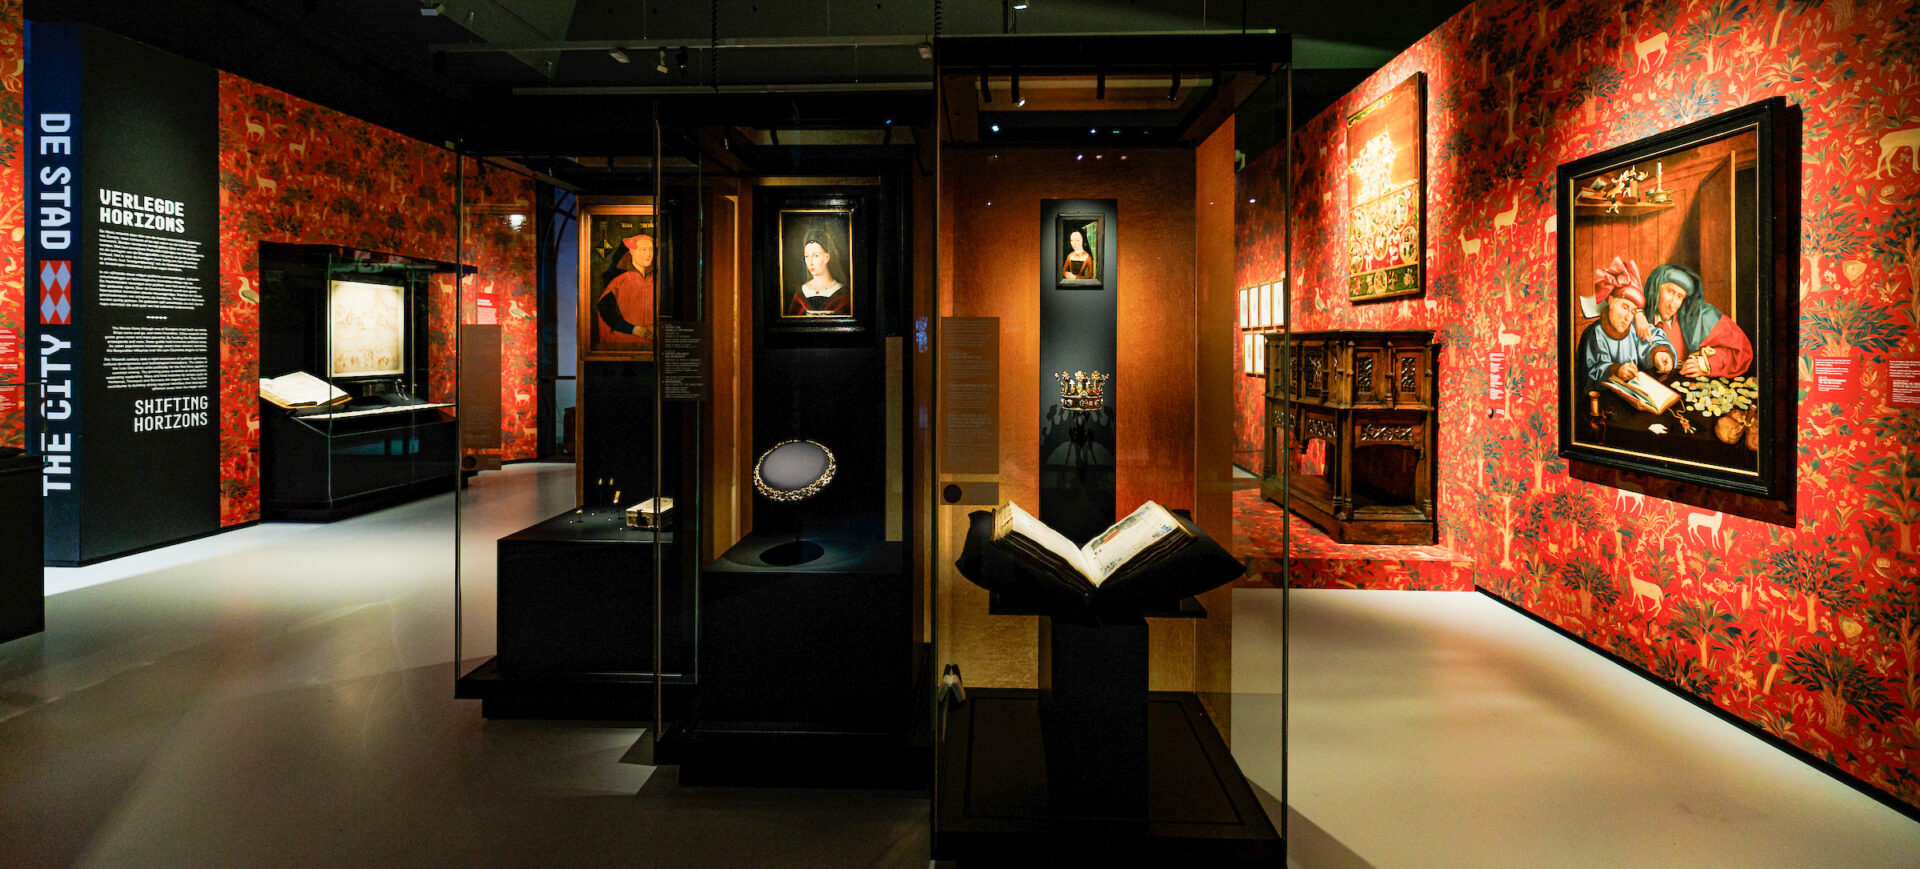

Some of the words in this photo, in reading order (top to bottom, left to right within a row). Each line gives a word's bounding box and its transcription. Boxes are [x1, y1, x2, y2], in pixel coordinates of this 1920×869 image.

[40, 113, 71, 155] DE
[40, 166, 72, 250] STAD
[99, 188, 185, 217] VERLEGDE
[99, 206, 185, 233] HORIZONS
[40, 333, 72, 420] CITY
[134, 412, 208, 432] HORIZONS
[135, 396, 208, 415] SHIFTING
[40, 432, 72, 497] THE
